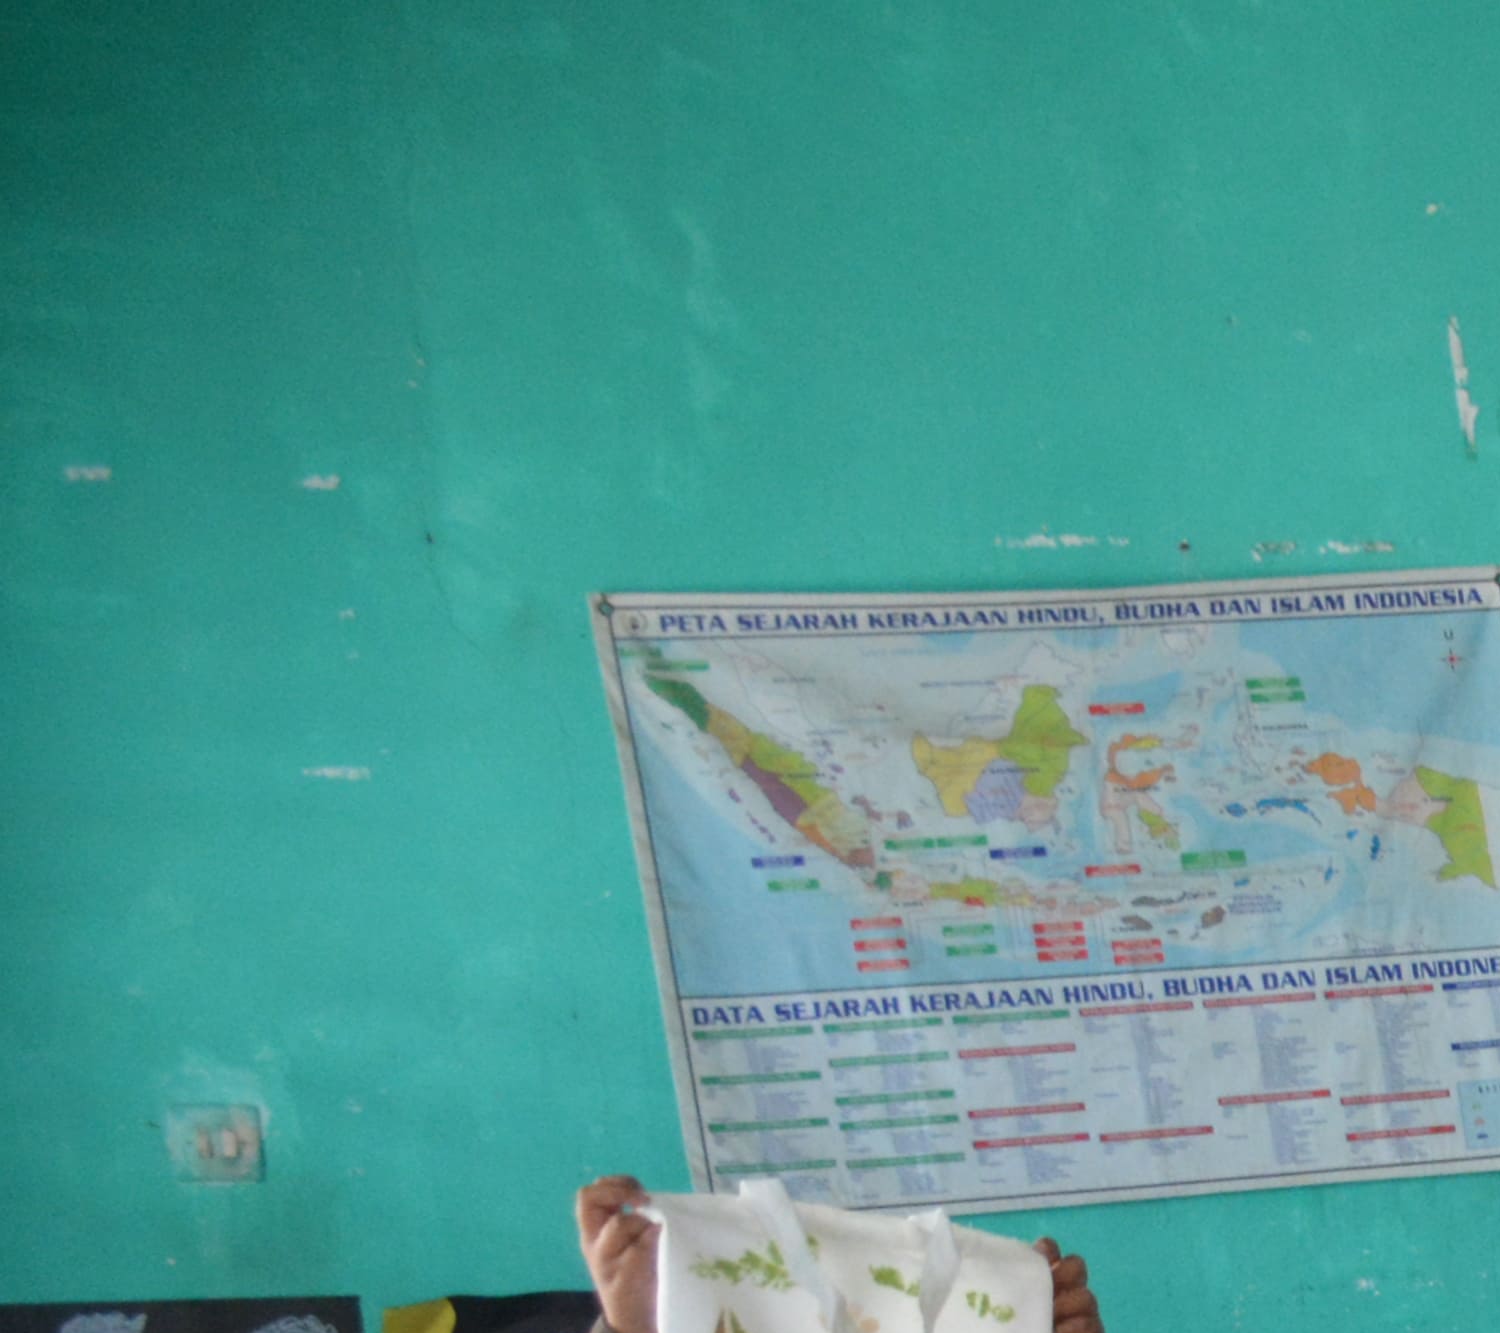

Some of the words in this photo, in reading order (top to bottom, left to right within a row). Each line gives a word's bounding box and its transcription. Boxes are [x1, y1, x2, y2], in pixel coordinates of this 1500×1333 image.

[659, 613, 728, 633] PETA
[737, 611, 859, 632] SEJARAH
[867, 609, 1009, 630] KERAJAAN
[1115, 601, 1201, 621] BUDHA
[1209, 597, 1261, 617] DAN
[1271, 594, 1346, 613] ISLAM
[1354, 587, 1484, 610] INDONESIA
[692, 1004, 765, 1026] DATA
[774, 1000, 900, 1022] SEJARAH
[910, 990, 1055, 1014] KERAJAAN
[1063, 981, 1155, 1003] HINDU,
[1163, 973, 1254, 997] BUDHA
[1261, 969, 1317, 990] DAN
[1325, 963, 1403, 985] ISLAM
